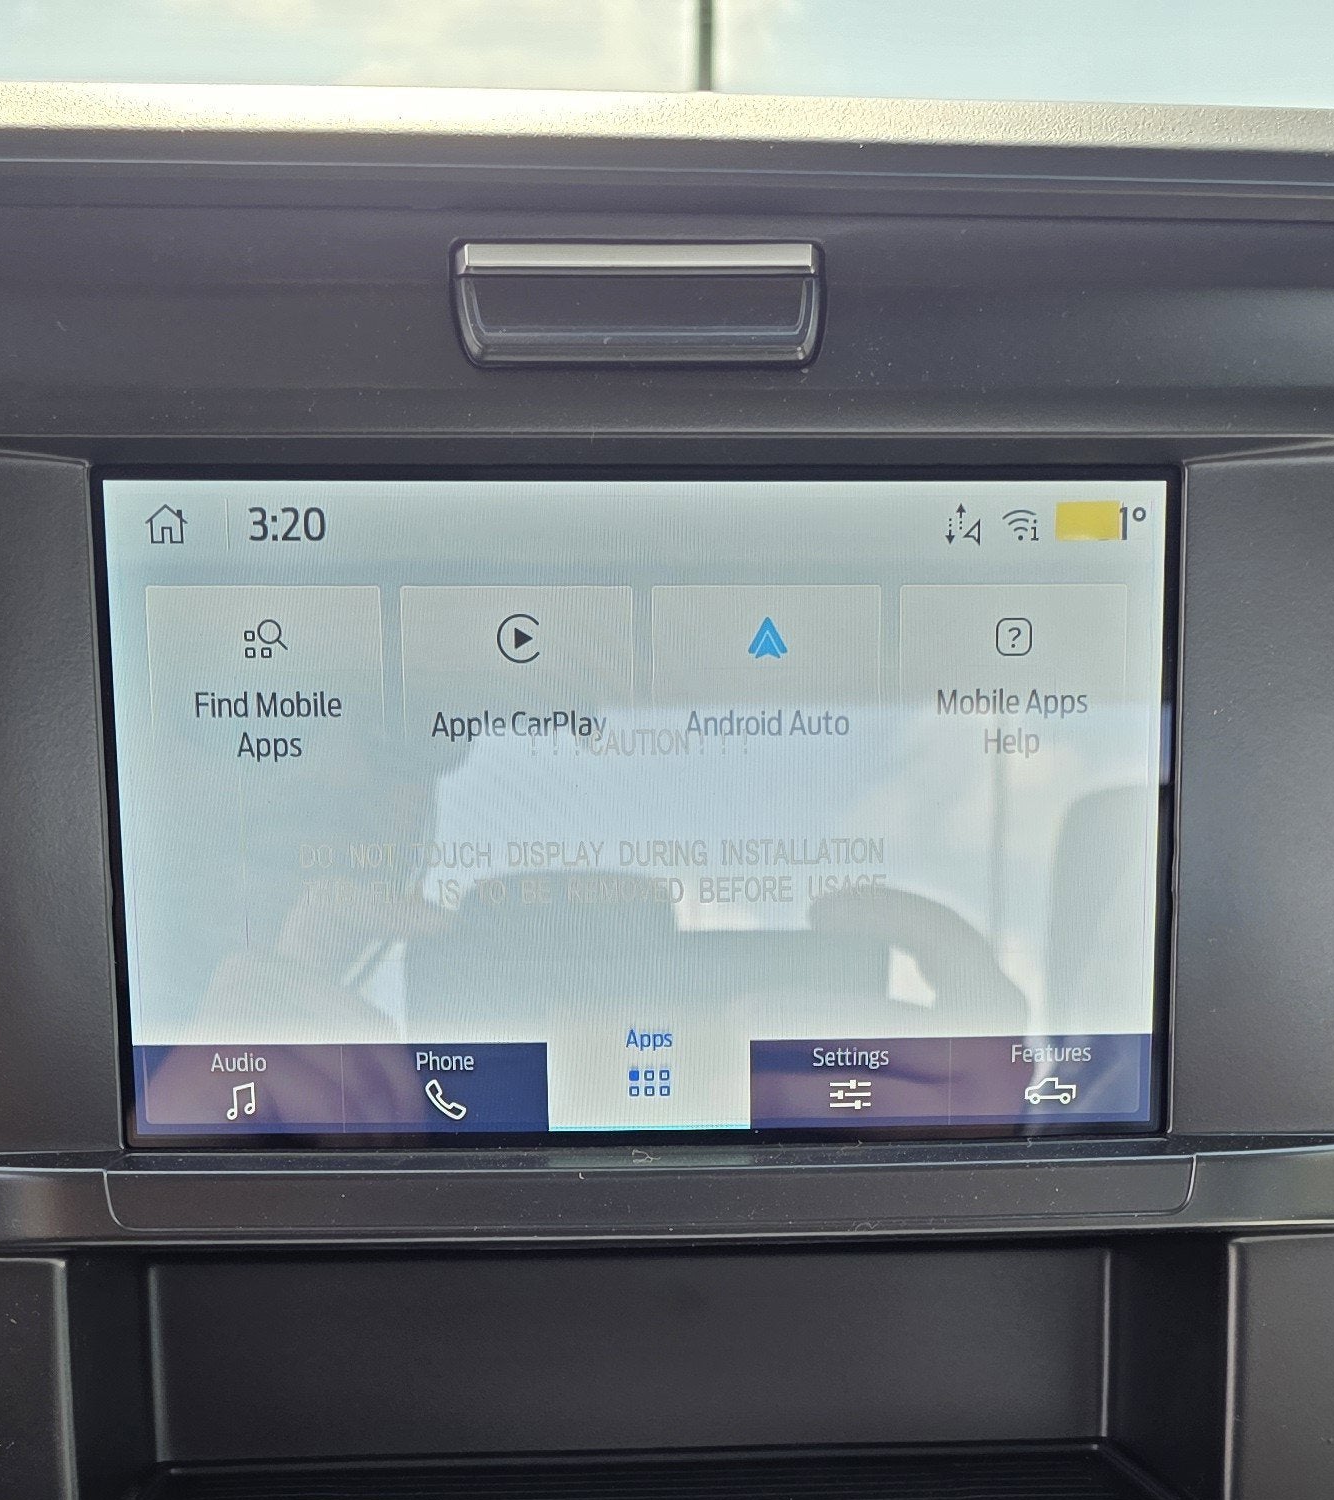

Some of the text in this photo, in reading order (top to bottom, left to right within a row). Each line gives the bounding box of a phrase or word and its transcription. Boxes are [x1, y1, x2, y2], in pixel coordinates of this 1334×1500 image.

[247, 506, 326, 541] 3:20
[195, 692, 342, 718] Find Mobile
[937, 689, 1088, 719] Mobile Apps
[432, 711, 606, 743] Apple CarPlay
[687, 710, 850, 737] Android Auto
[237, 732, 303, 762] Apps
[590, 729, 690, 757] CAUTION
[984, 728, 1040, 758] Help
[298, 837, 885, 869] DO NOT TOUCH DISPLAY DURING INSTALLATION
[699, 876, 794, 903] BEFORE
[626, 1029, 673, 1052] Apps
[1011, 1043, 1092, 1064] Features
[210, 1052, 267, 1073] Audio
[416, 1051, 474, 1072] Phone
[813, 1047, 889, 1070] Settings
